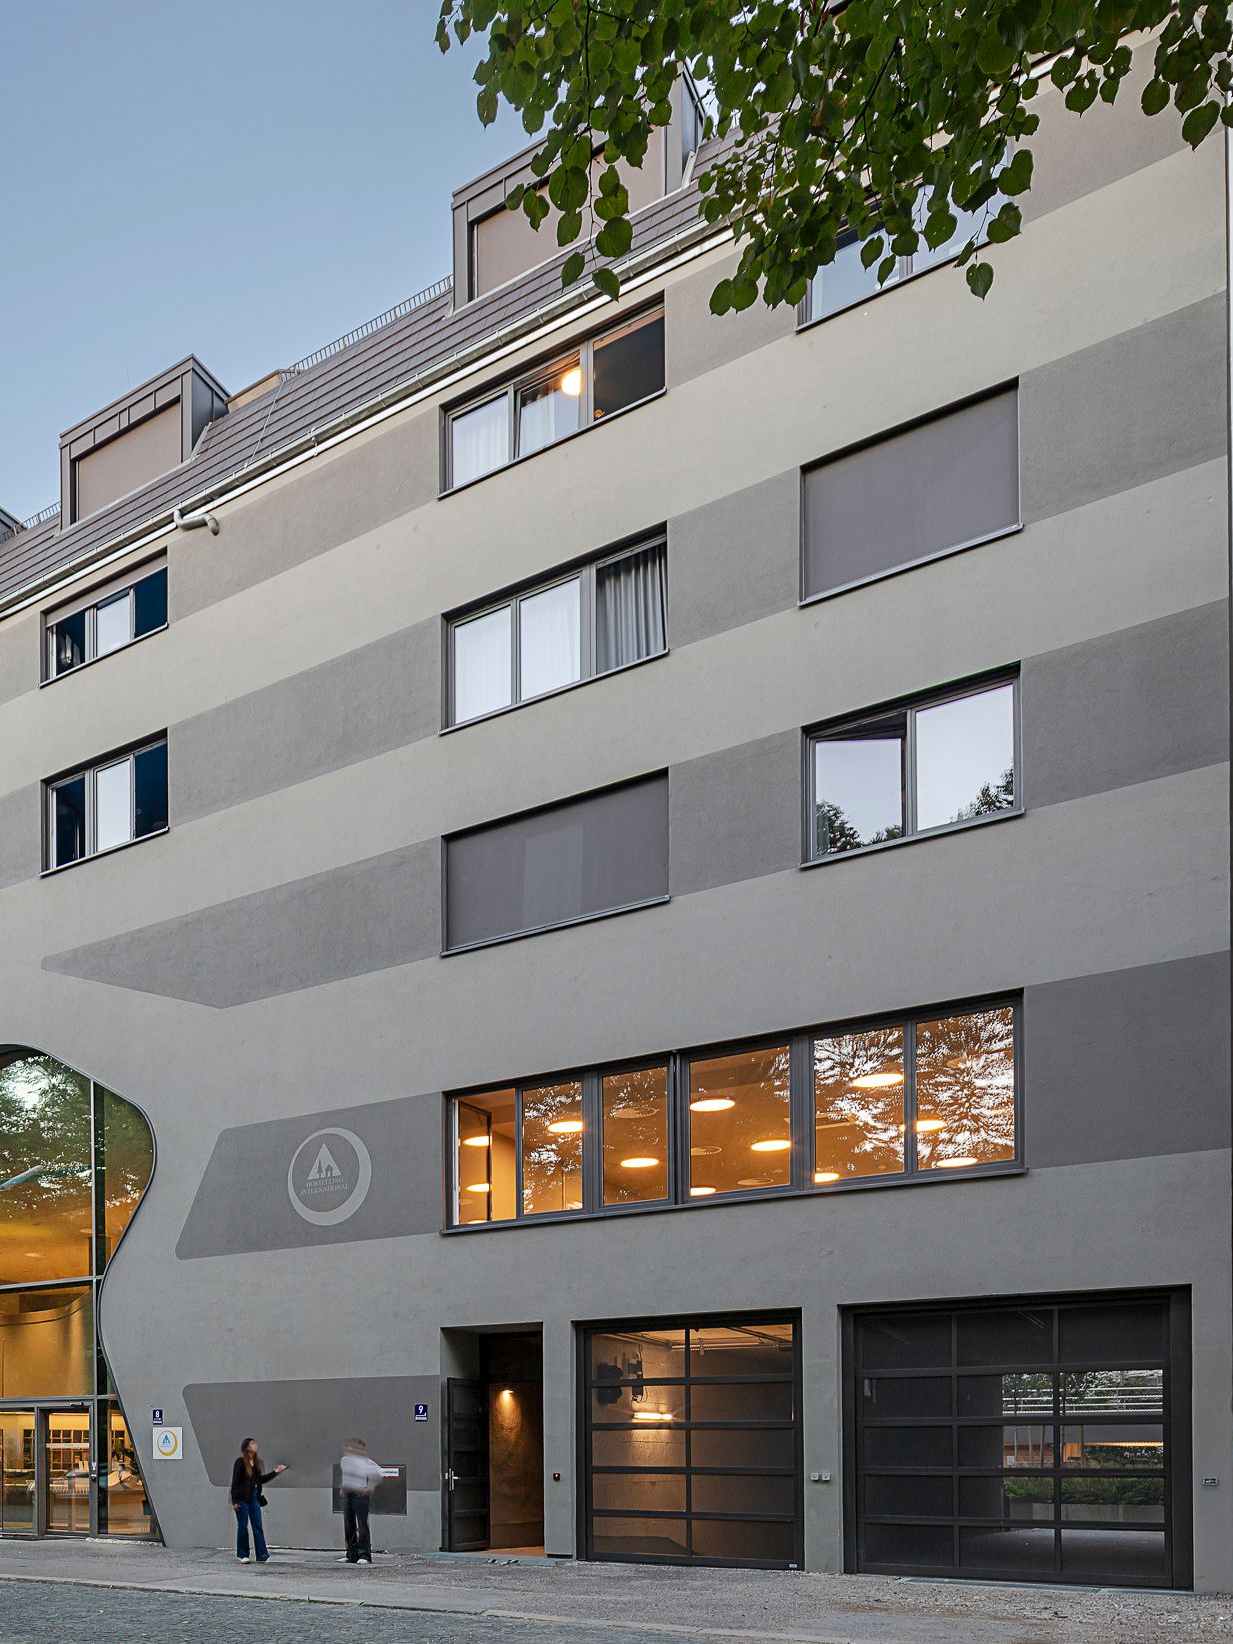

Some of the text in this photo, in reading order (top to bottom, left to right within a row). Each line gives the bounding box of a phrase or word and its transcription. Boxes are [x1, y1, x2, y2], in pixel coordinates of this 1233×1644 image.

[306, 1177, 344, 1188] HOSTELLING
[300, 1183, 350, 1195] INTERNATIONAL
[418, 1405, 424, 1414] 9
